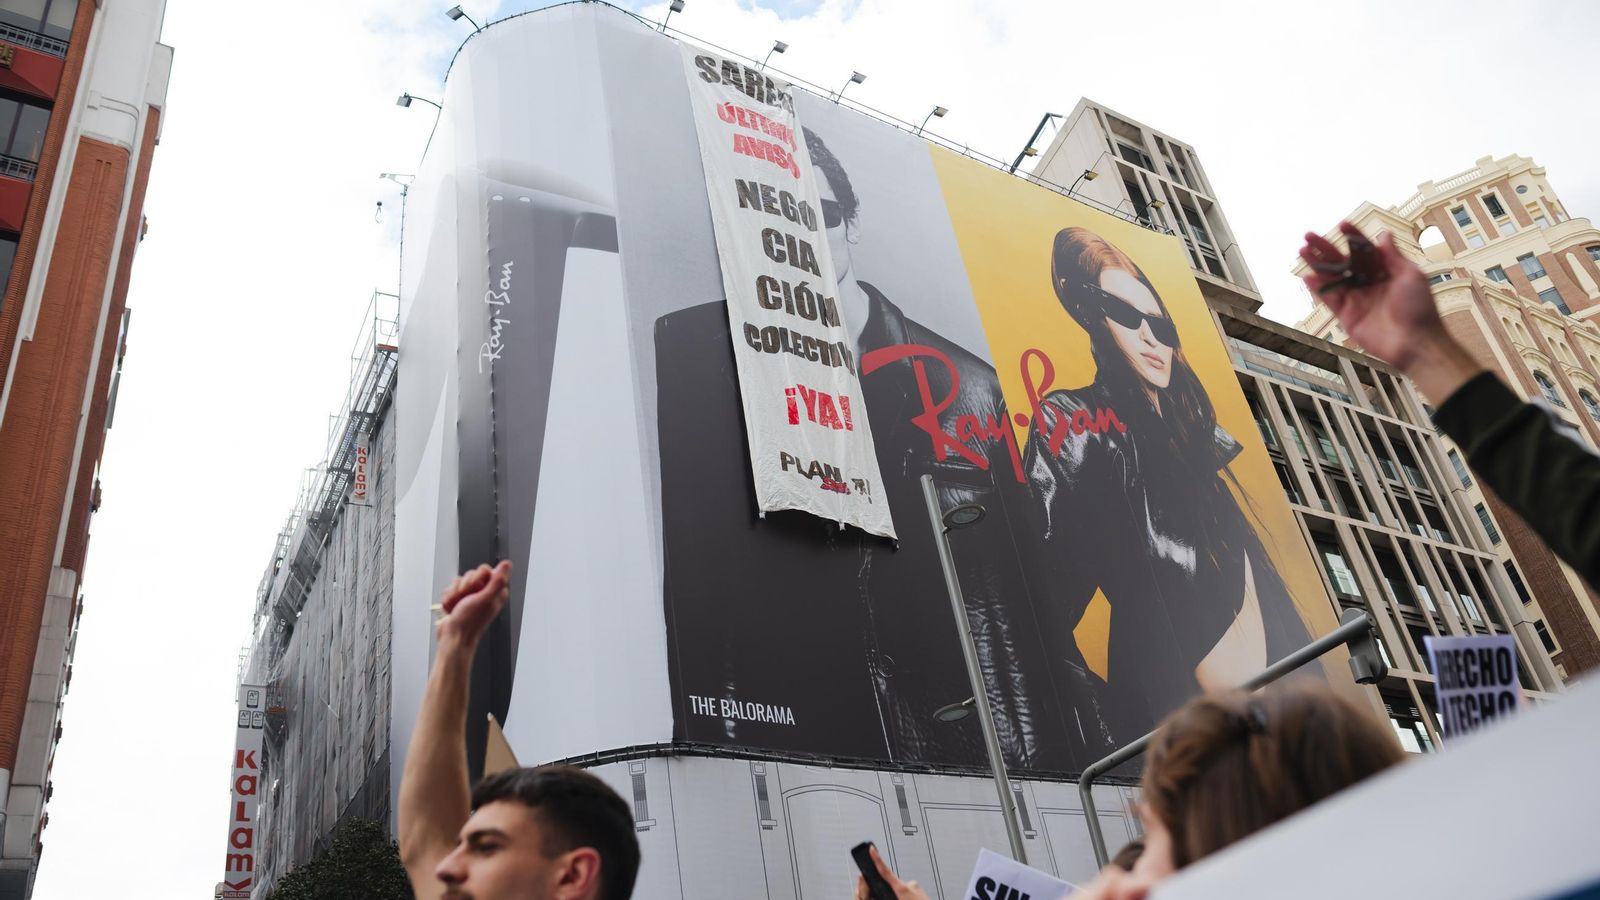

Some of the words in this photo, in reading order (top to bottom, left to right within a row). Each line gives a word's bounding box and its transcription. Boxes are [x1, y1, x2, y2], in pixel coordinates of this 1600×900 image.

[735, 178, 818, 232] NEGO
[761, 227, 822, 277] CIA
[755, 275, 841, 328] CIÓN
[743, 321, 857, 378] COLECTIV
[784, 384, 854, 432] ¡YA!
[780, 451, 843, 483] PLAN
[689, 695, 718, 717] THE
[720, 698, 796, 726] BALORAMA
